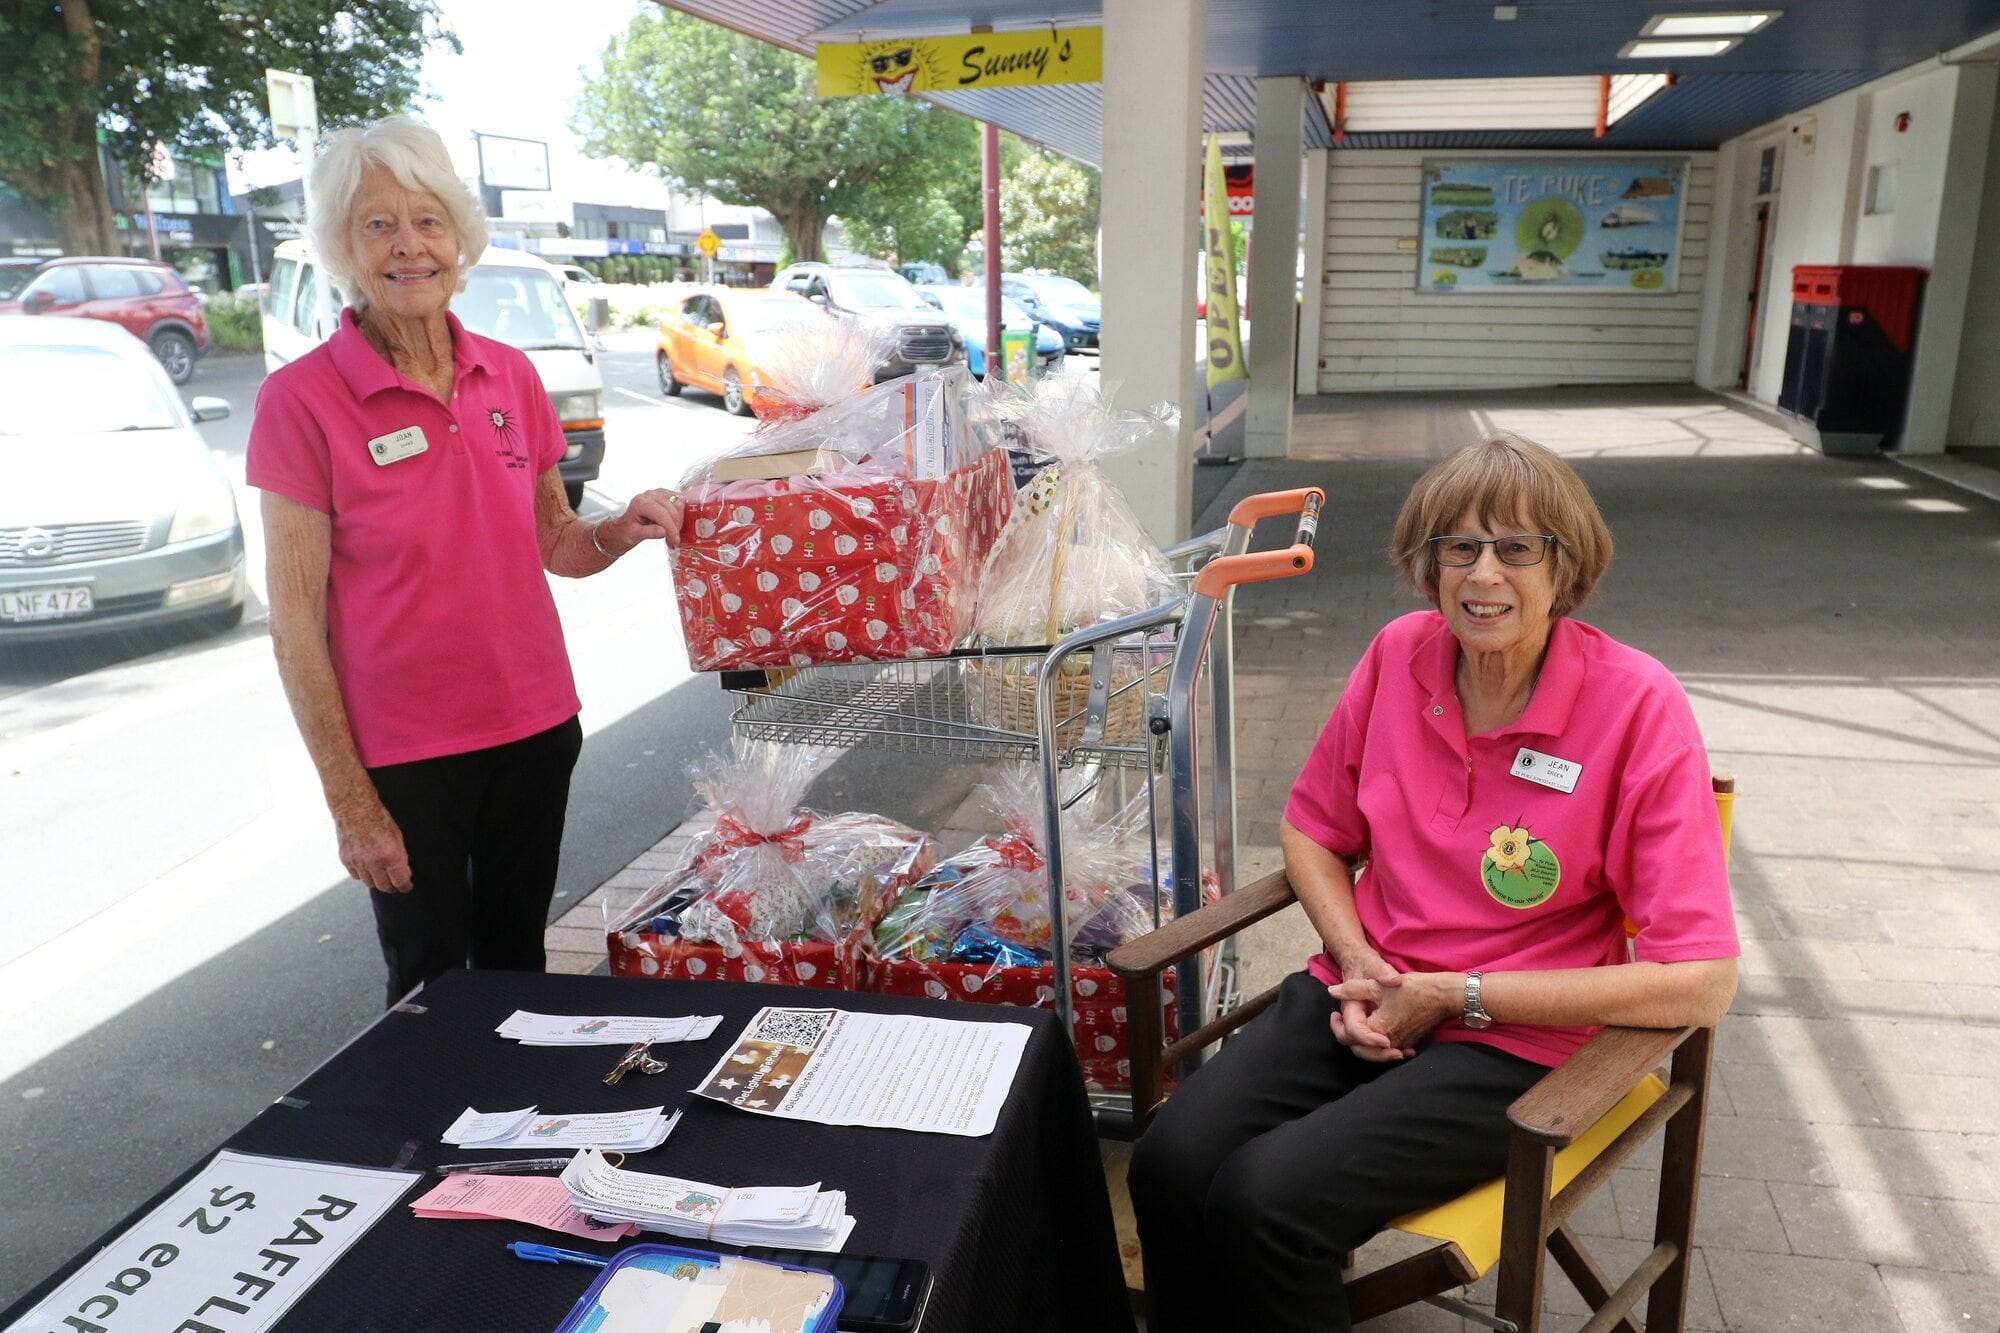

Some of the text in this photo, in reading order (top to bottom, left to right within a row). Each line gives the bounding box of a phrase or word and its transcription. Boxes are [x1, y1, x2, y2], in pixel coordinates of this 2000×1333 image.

[959, 39, 1071, 84] Sunny's
[1504, 174, 1604, 205] TE PUKE
[396, 431, 413, 442] JOAN
[764, 504, 775, 520] HO
[804, 541, 815, 558] HO
[864, 534, 874, 551] HO
[826, 565, 840, 582] HO
[748, 603, 759, 620] HO
[866, 595, 876, 612] HO
[1546, 770, 1564, 778] GREEN
[1548, 760, 1570, 772] JEAN
[826, 969, 838, 984] HO
[1086, 1009, 1097, 1026] HO
[819, 1037, 836, 1058] Retailer
[832, 1014, 850, 1036] Benefits
[732, 1045, 784, 1106] #DeLightUpTePuke
[602, 1166, 621, 1178] 1021
[581, 1177, 673, 1212] TePuke KiwiCoast Lions
[177, 1185, 257, 1234] $2
